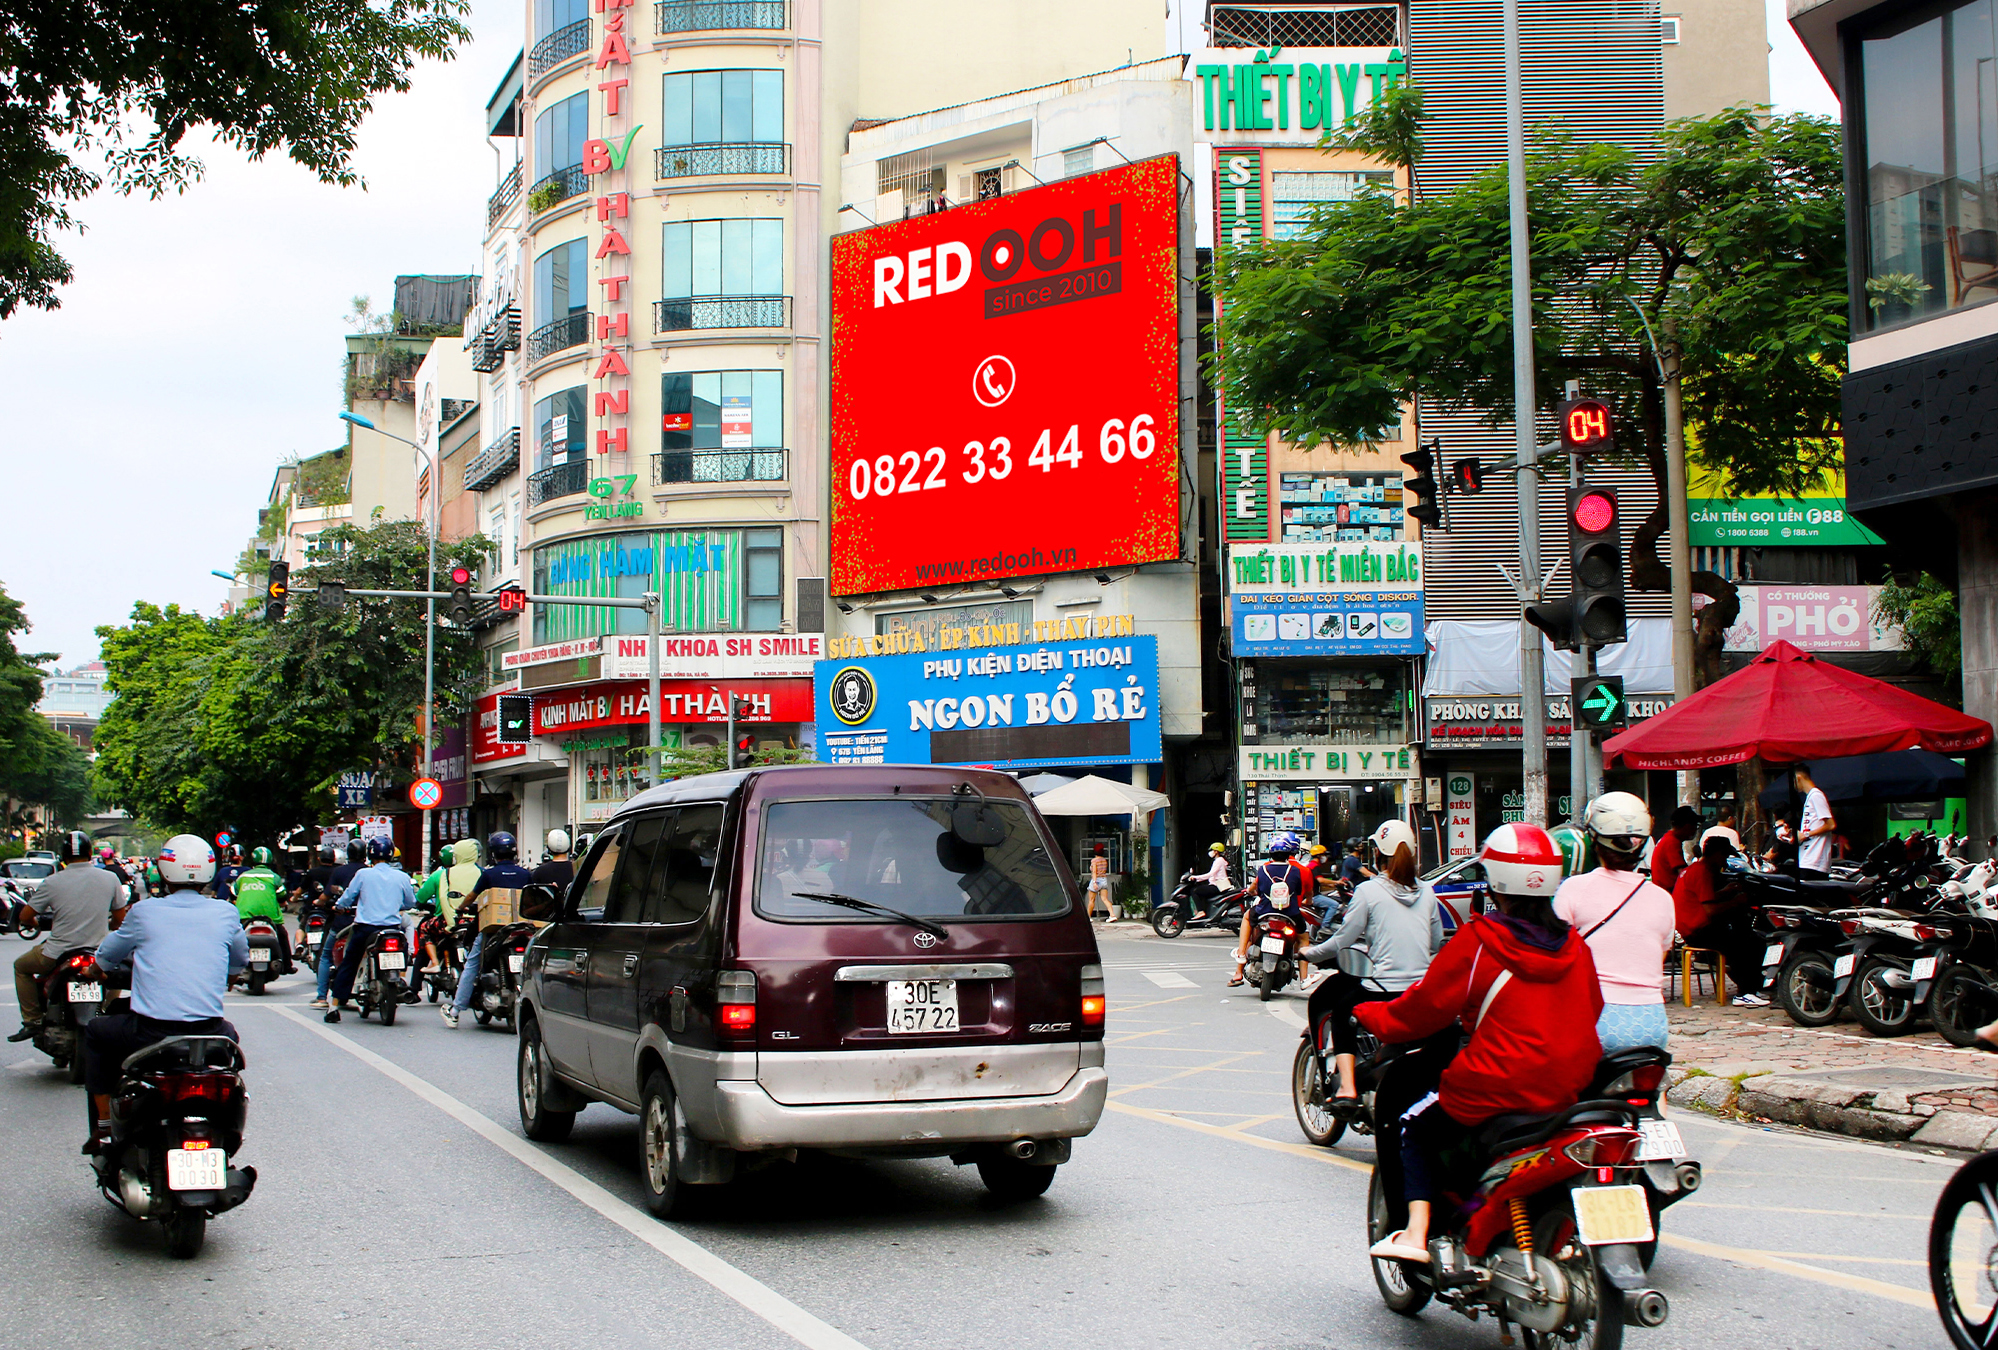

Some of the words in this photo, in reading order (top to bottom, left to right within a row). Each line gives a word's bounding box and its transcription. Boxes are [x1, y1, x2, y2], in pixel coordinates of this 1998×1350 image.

[1196, 46, 1294, 130] THIẾT
[1299, 62, 1332, 138] BỊ
[1335, 63, 1360, 127] Y
[874, 240, 972, 308] RED
[980, 202, 1122, 282] OOH
[992, 286, 1051, 312] since
[1058, 268, 1113, 298] 2010
[1569, 411, 1606, 442] 04
[850, 447, 947, 500] 0822
[962, 436, 1012, 484] 33
[1028, 424, 1083, 473] 44
[1100, 413, 1156, 464] 66
[588, 474, 637, 497] 67
[583, 501, 607, 520] YÊN
[1690, 507, 1719, 522] CẦN
[1721, 507, 1747, 522] TIỀN
[1750, 512, 1775, 525] GỌI
[1778, 507, 1803, 522] LIỀN
[600, 545, 652, 578] HÀM
[665, 538, 725, 578] MẶT
[915, 545, 1077, 580] www.redooh.vn
[1233, 548, 1275, 584] THIẾT
[1280, 555, 1297, 587] BỊ
[1300, 554, 1310, 582] Y
[1316, 547, 1337, 582] TẾ
[1340, 545, 1381, 582] MIỀN
[1386, 544, 1419, 581] BẮC
[501, 591, 524, 611] 04
[1240, 595, 1258, 603] ĐAI
[1262, 592, 1284, 603] KÉO
[1317, 592, 1339, 604] CỘT
[1767, 597, 1860, 636] PHỞ
[940, 623, 964, 650] ÉP
[968, 618, 1020, 648] KÍNH
[1034, 617, 1090, 642] THAY
[1096, 614, 1135, 636] PIN
[618, 639, 646, 657] NH
[666, 639, 719, 657] KHOA
[726, 639, 752, 656] SH
[759, 638, 820, 655] SMILE
[923, 658, 961, 681] PHỤ
[967, 653, 1012, 679] KIỆN
[1016, 648, 1063, 675] ĐIỆN
[1072, 646, 1132, 671] THOẠI
[541, 699, 566, 727] KÍNH
[569, 690, 594, 722] MẮT
[907, 693, 1015, 731] NGON
[1024, 674, 1079, 725] BỔ
[1091, 674, 1147, 720] RẺ
[1431, 699, 1491, 720] PHÒNG
[1549, 696, 1572, 719] SẢ
[1248, 747, 1315, 769] THIẾT
[1326, 752, 1348, 773] BỊ
[1358, 752, 1372, 769] Y
[1382, 746, 1412, 769] TẾ
[1638, 756, 1703, 768] HIGHLANDS
[1706, 752, 1746, 763] COFFEE
[345, 789, 366, 805] XE
[1450, 780, 1470, 791] 128
[1450, 800, 1471, 810] SIÊU
[1452, 815, 1470, 825] ÂM
[1458, 831, 1465, 839] 4
[242, 881, 266, 892] Grab
[904, 982, 941, 1005] 30E
[772, 1031, 800, 1040] GL
